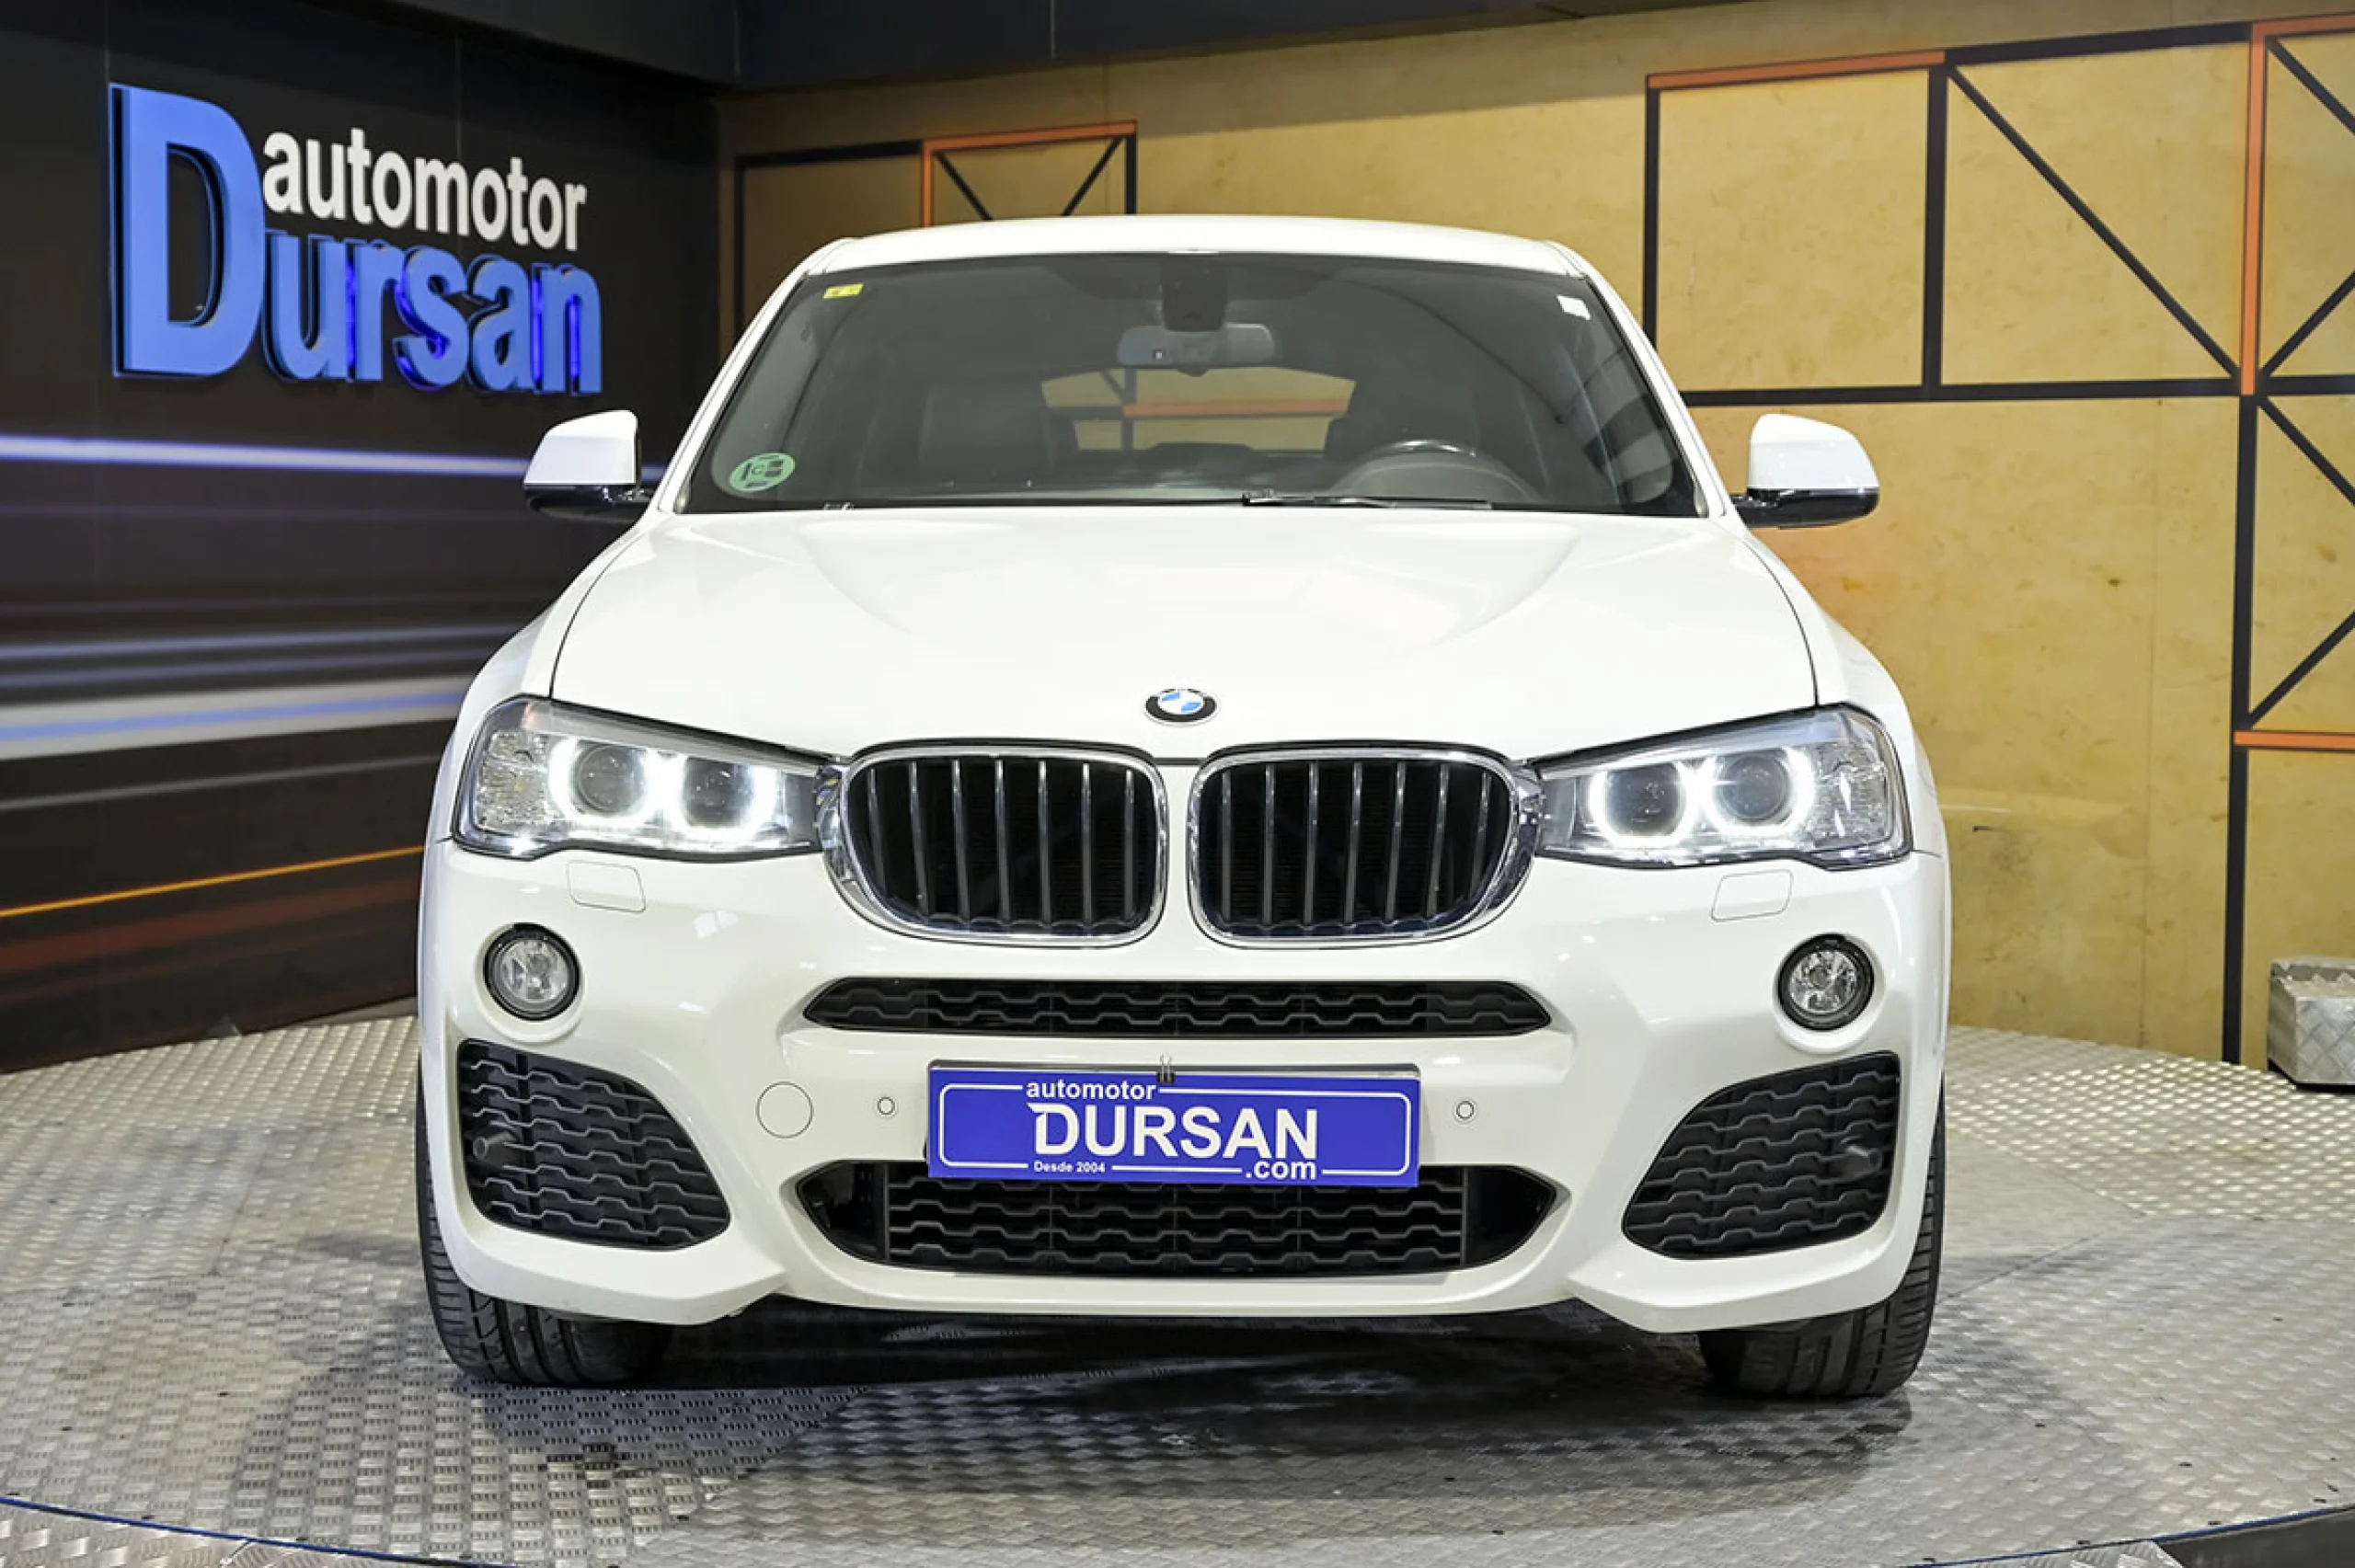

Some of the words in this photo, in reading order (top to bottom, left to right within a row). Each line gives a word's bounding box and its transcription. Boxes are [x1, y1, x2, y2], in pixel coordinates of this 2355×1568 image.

[262, 127, 588, 251] automotor
[109, 82, 603, 396] Dursan
[1026, 1078, 1156, 1100] automotor
[1027, 1103, 1318, 1161] DURSAN
[1033, 1160, 1073, 1173] Desde
[1076, 1161, 1106, 1173] 2004
[1246, 1161, 1317, 1180] .com
